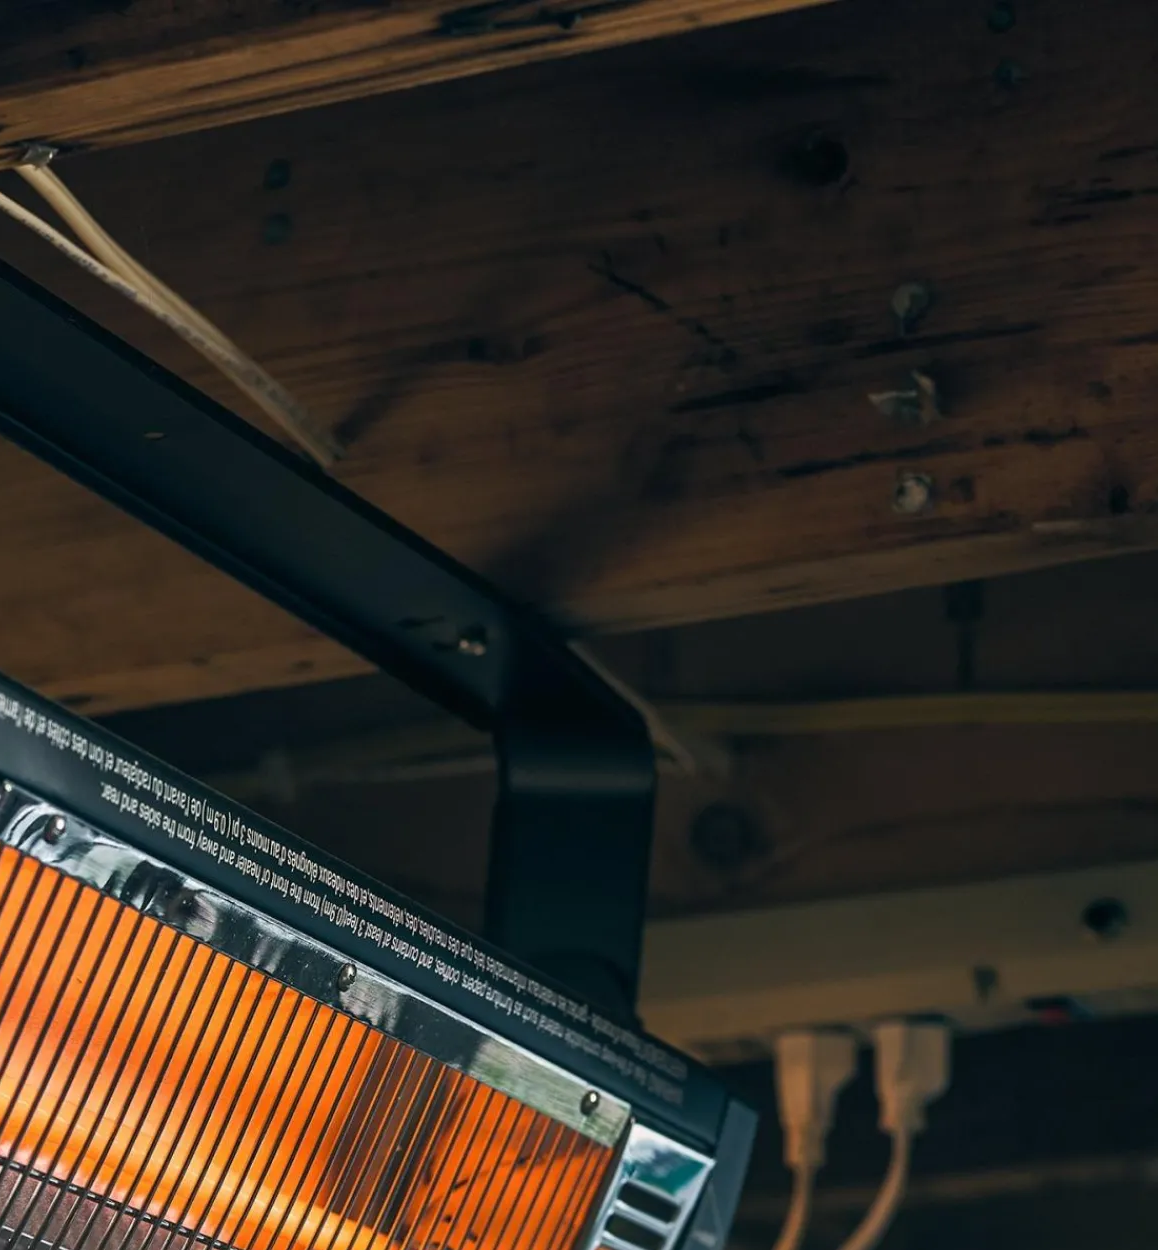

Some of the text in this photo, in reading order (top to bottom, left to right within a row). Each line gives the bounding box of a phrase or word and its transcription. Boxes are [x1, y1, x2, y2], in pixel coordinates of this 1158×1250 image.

[22, 707, 36, 731] de
[70, 733, 88, 759] des
[87, 742, 104, 769] loin
[103, 750, 114, 771] et
[100, 781, 120, 805] rear.
[150, 776, 163, 801] du
[162, 782, 191, 817] l'avant
[118, 792, 138, 814] and
[137, 801, 162, 829] sides
[189, 797, 202, 821] de
[161, 814, 176, 838] the
[175, 822, 196, 850] from
[238, 823, 247, 846] 3
[195, 829, 219, 857] away
[245, 827, 270, 854] moins
[268, 839, 287, 866] d'au
[216, 844, 236, 865] and
[286, 848, 318, 883] éloignés
[234, 854, 261, 884] heater
[258, 867, 271, 886] of
[317, 865, 346, 897] rideaux
[269, 871, 290, 898] front
[288, 881, 303, 904] the
[345, 879, 360, 905] des
[302, 889, 321, 914] from
[356, 918, 366, 937] 3
[362, 921, 384, 947] least
[380, 930, 392, 949] at
[389, 935, 419, 962] curtains
[446, 934, 460, 958] des
[459, 941, 474, 962] que
[415, 950, 434, 969] and
[433, 956, 460, 986] clothes,
[512, 1000, 523, 1016] as
